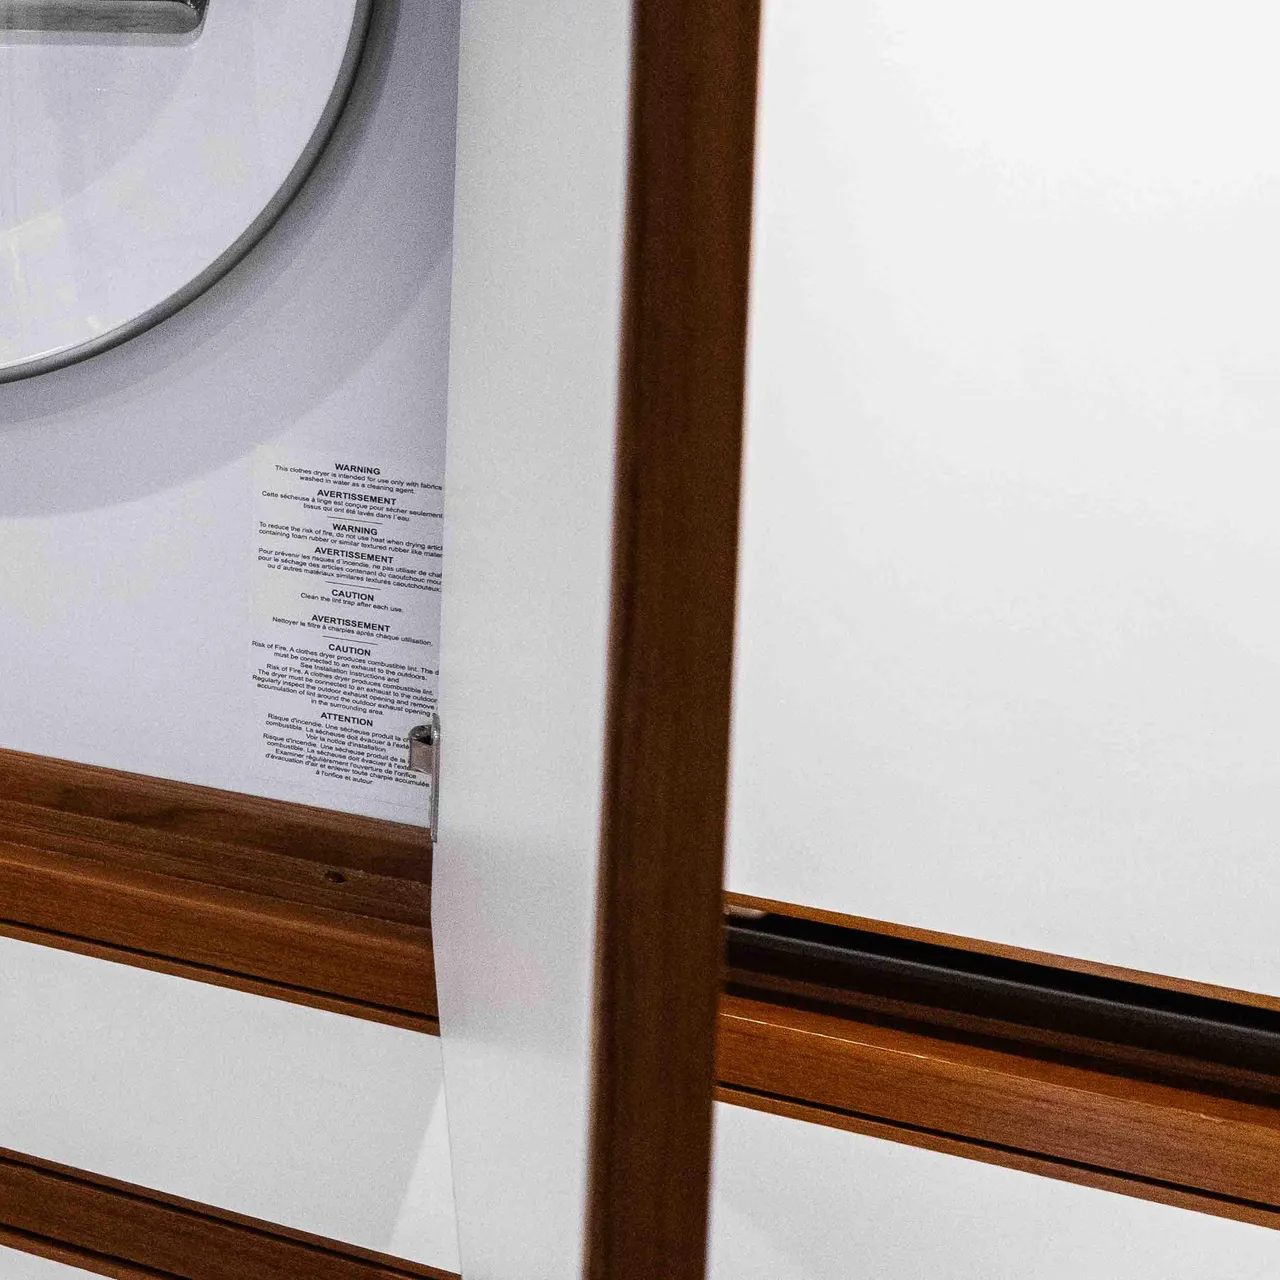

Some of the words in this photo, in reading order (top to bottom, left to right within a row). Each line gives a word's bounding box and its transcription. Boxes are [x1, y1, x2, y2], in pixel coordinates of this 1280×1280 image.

[289, 466, 311, 474] clothes
[313, 469, 329, 477] dryer
[338, 472, 365, 480] intended
[334, 463, 380, 475] WARNING
[299, 474, 323, 482] washed
[332, 478, 349, 486] water
[366, 482, 393, 492] cleaning
[316, 489, 396, 505] AVERTISSEMENT
[267, 522, 289, 530] reduce
[405, 540, 425, 550] drying
[332, 523, 377, 535] WARNING
[258, 528, 289, 538] containing
[308, 534, 328, 542] rubber
[338, 538, 359, 546] similar
[388, 545, 409, 553] rubber
[314, 546, 393, 563] AVERTISSEMENT
[300, 592, 318, 600] Clean
[342, 598, 355, 606] trap
[356, 600, 371, 608] after
[372, 602, 388, 610] each
[331, 588, 374, 601] CAUTION
[311, 614, 390, 632] AVERTISSEMENT
[295, 647, 317, 655] clothes
[318, 650, 335, 660] dryer
[336, 653, 365, 664] produces
[367, 658, 405, 670] combustible
[328, 643, 370, 656] CAUTION
[273, 650, 288, 658] must
[299, 654, 332, 665] connected
[350, 663, 376, 672] exhaust
[266, 662, 279, 670] Risk
[310, 670, 332, 678] clothes
[333, 674, 350, 683] dryer
[351, 676, 380, 688] produces
[382, 682, 420, 693] combustible
[270, 670, 286, 679] dryer
[288, 673, 303, 681] must
[314, 677, 347, 688] connected
[366, 686, 391, 695] exhaust
[252, 674, 280, 685] Regularly
[282, 679, 304, 689] inspect
[317, 685, 341, 694] outdoor
[342, 689, 367, 698] exhaust
[369, 693, 394, 704] opening
[410, 701, 434, 710] remove
[257, 682, 297, 693] accumulation
[316, 692, 338, 700] around
[351, 697, 376, 707] outdoor
[377, 702, 403, 711] exhaust
[404, 706, 430, 717] opening
[329, 701, 367, 714] surrounding
[320, 711, 373, 726] ATTENTION
